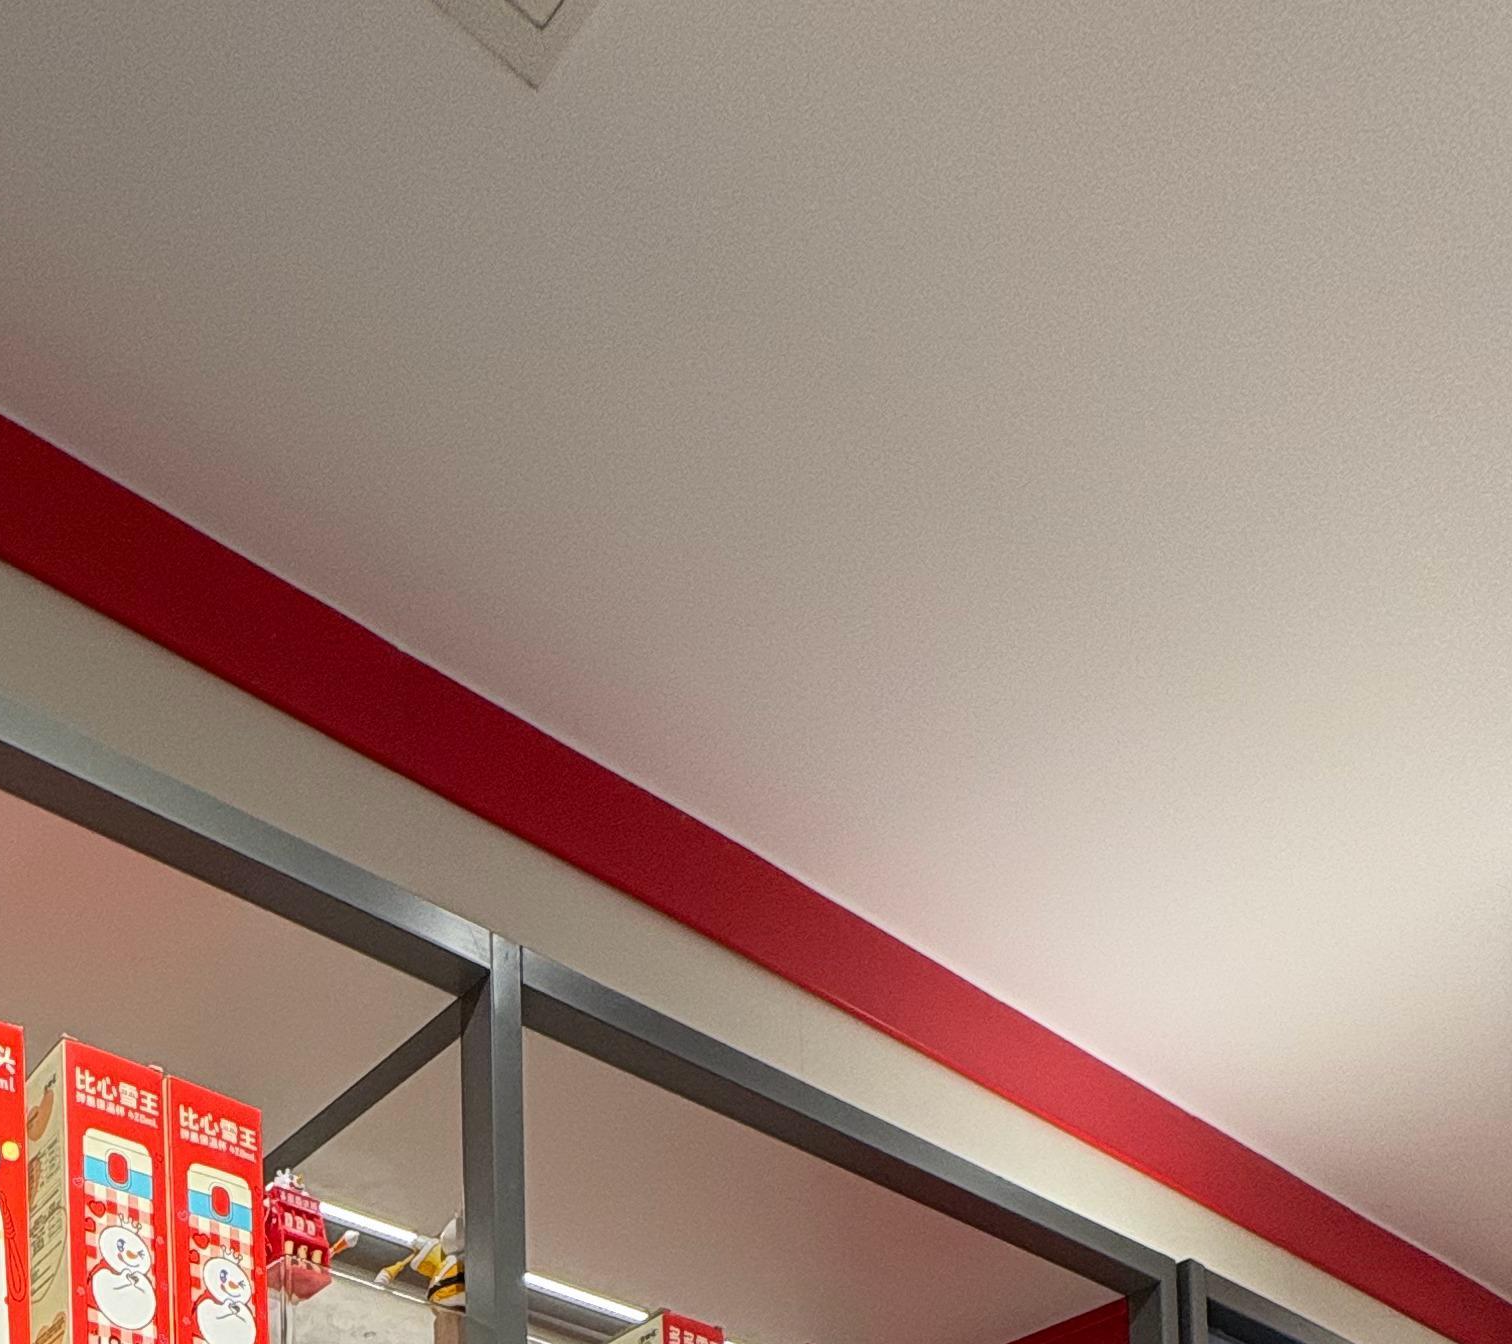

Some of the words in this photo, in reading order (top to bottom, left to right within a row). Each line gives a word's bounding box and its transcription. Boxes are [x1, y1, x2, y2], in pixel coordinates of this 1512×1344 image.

[75, 1065, 160, 1117] 比心雪王
[178, 1103, 258, 1151] 比心雪王
